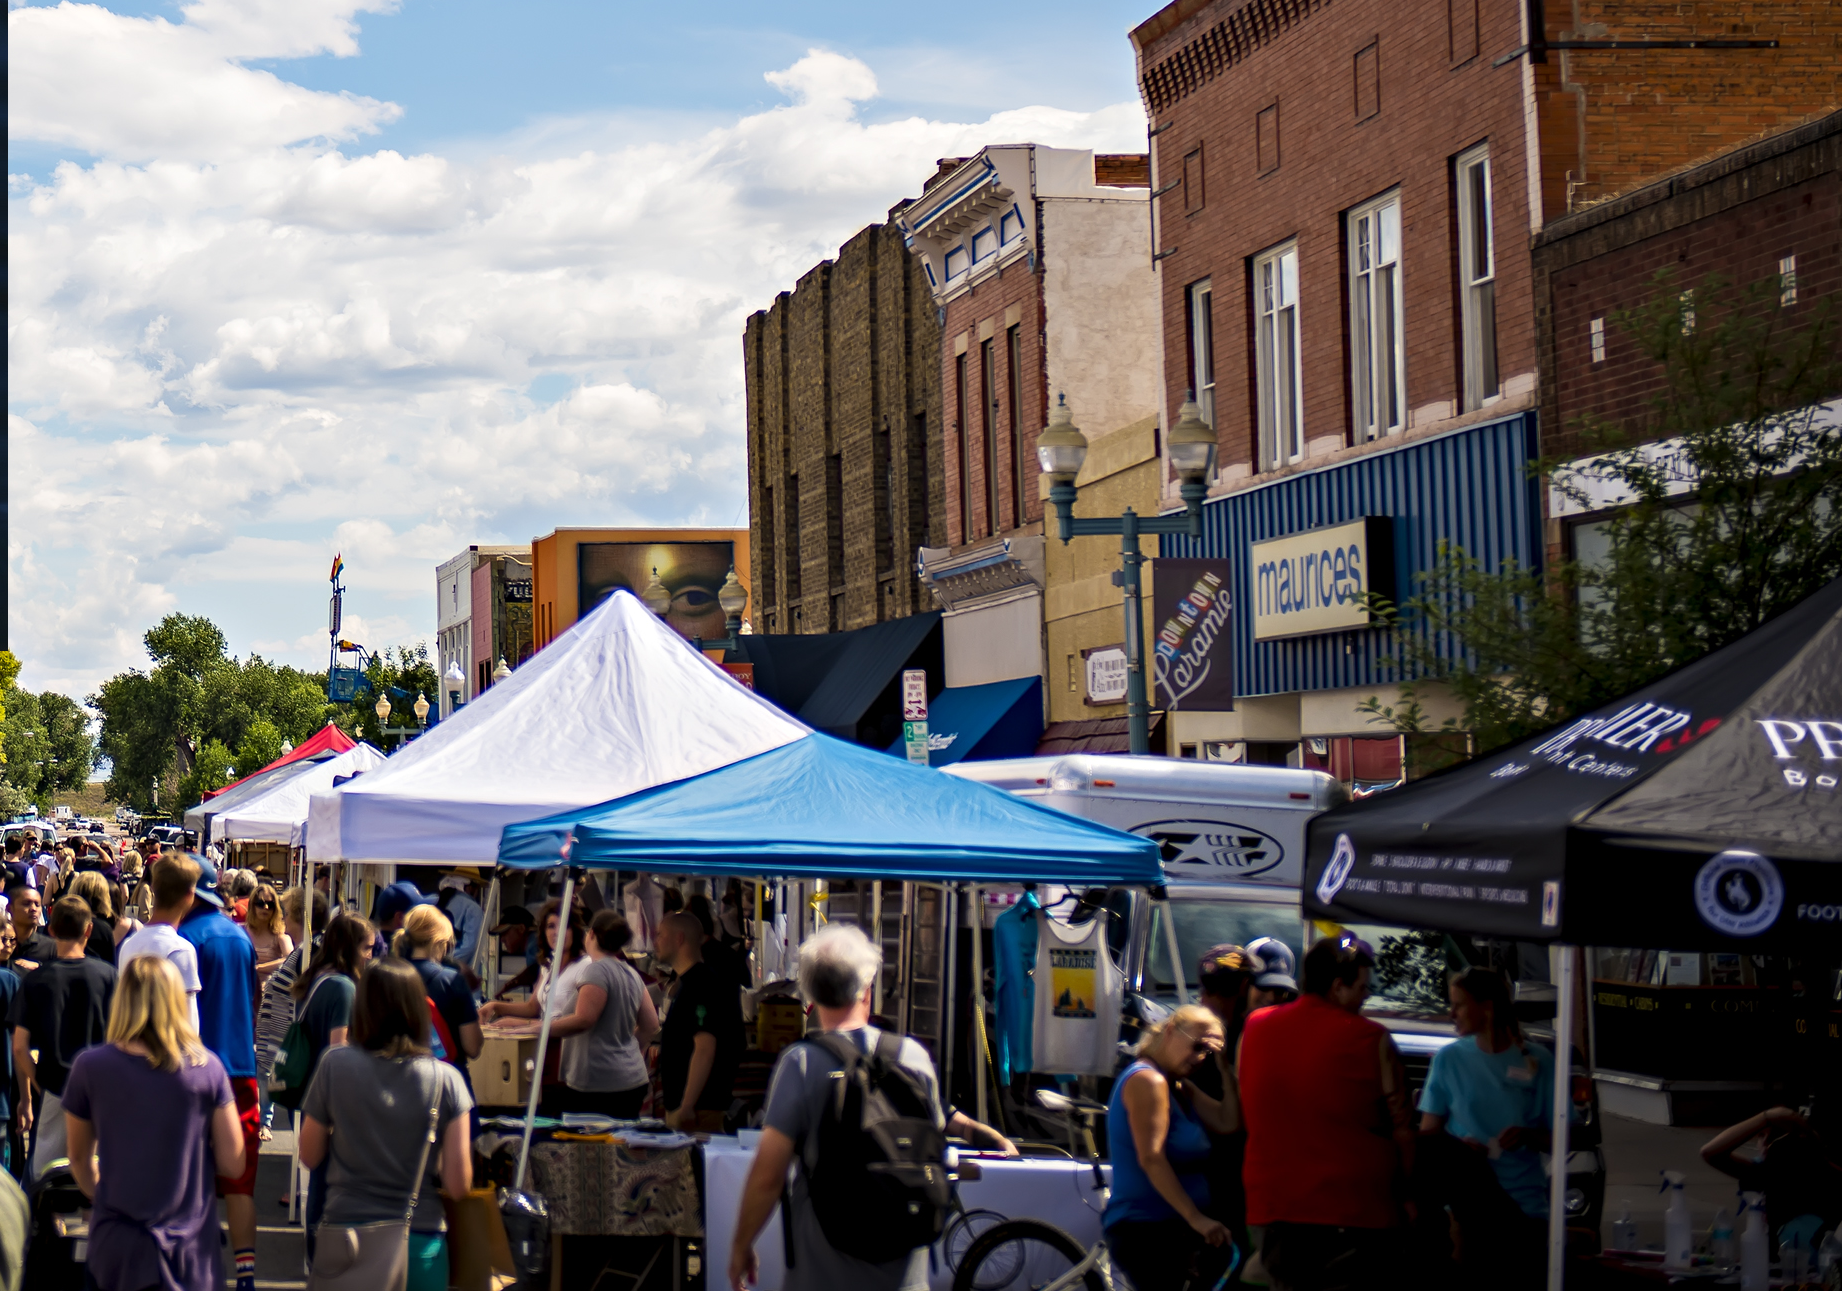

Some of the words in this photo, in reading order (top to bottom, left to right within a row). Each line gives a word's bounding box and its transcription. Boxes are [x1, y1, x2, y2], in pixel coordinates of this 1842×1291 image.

[1258, 543, 1362, 617] maurices
[1154, 589, 1233, 711] Laramie
[905, 725, 913, 739] 2
[1567, 752, 1640, 779] Centers
